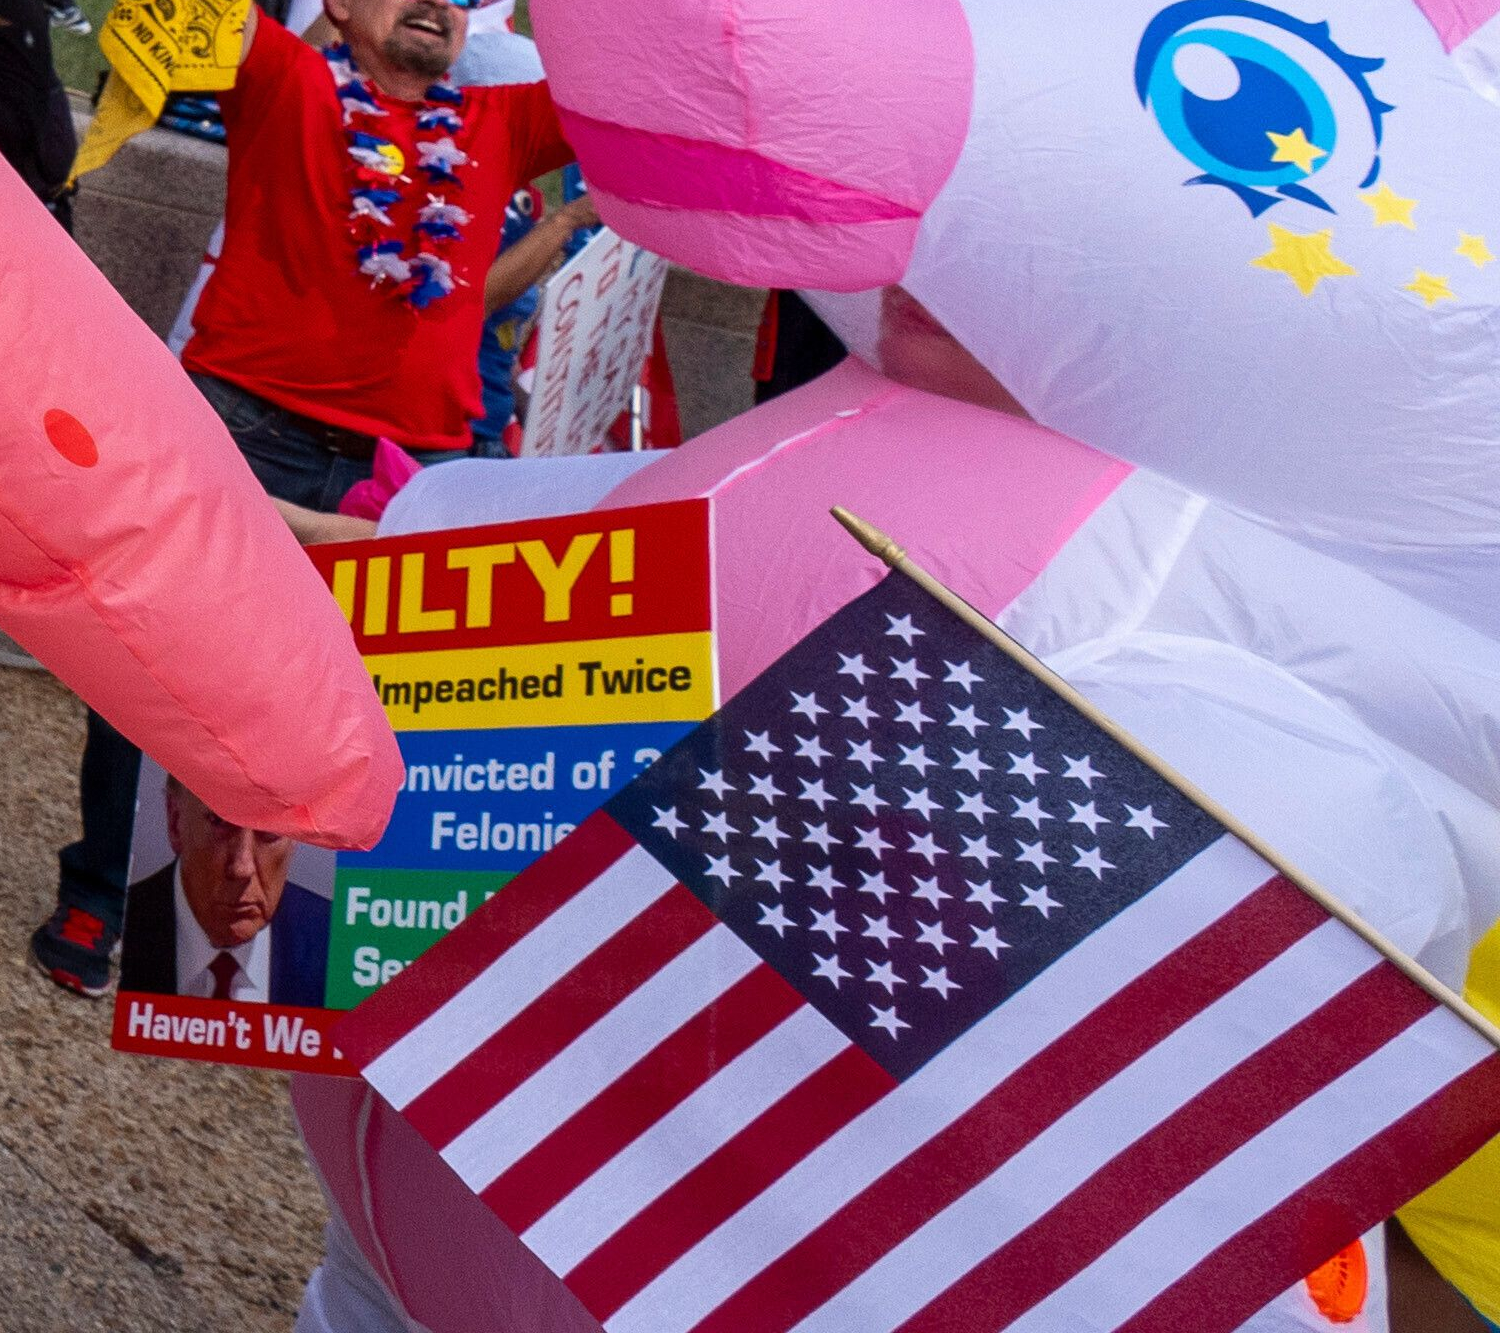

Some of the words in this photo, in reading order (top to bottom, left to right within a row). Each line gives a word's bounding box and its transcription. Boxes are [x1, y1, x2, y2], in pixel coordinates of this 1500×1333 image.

[133, 21, 154, 46] NO
[332, 527, 636, 637] ILTY!
[578, 658, 693, 697] Twice
[398, 751, 556, 792] nvicted
[572, 747, 616, 790] of
[431, 811, 581, 852] Felonie
[346, 886, 469, 931] Found
[128, 1001, 252, 1051] Haven't
[262, 1013, 323, 1059] We
